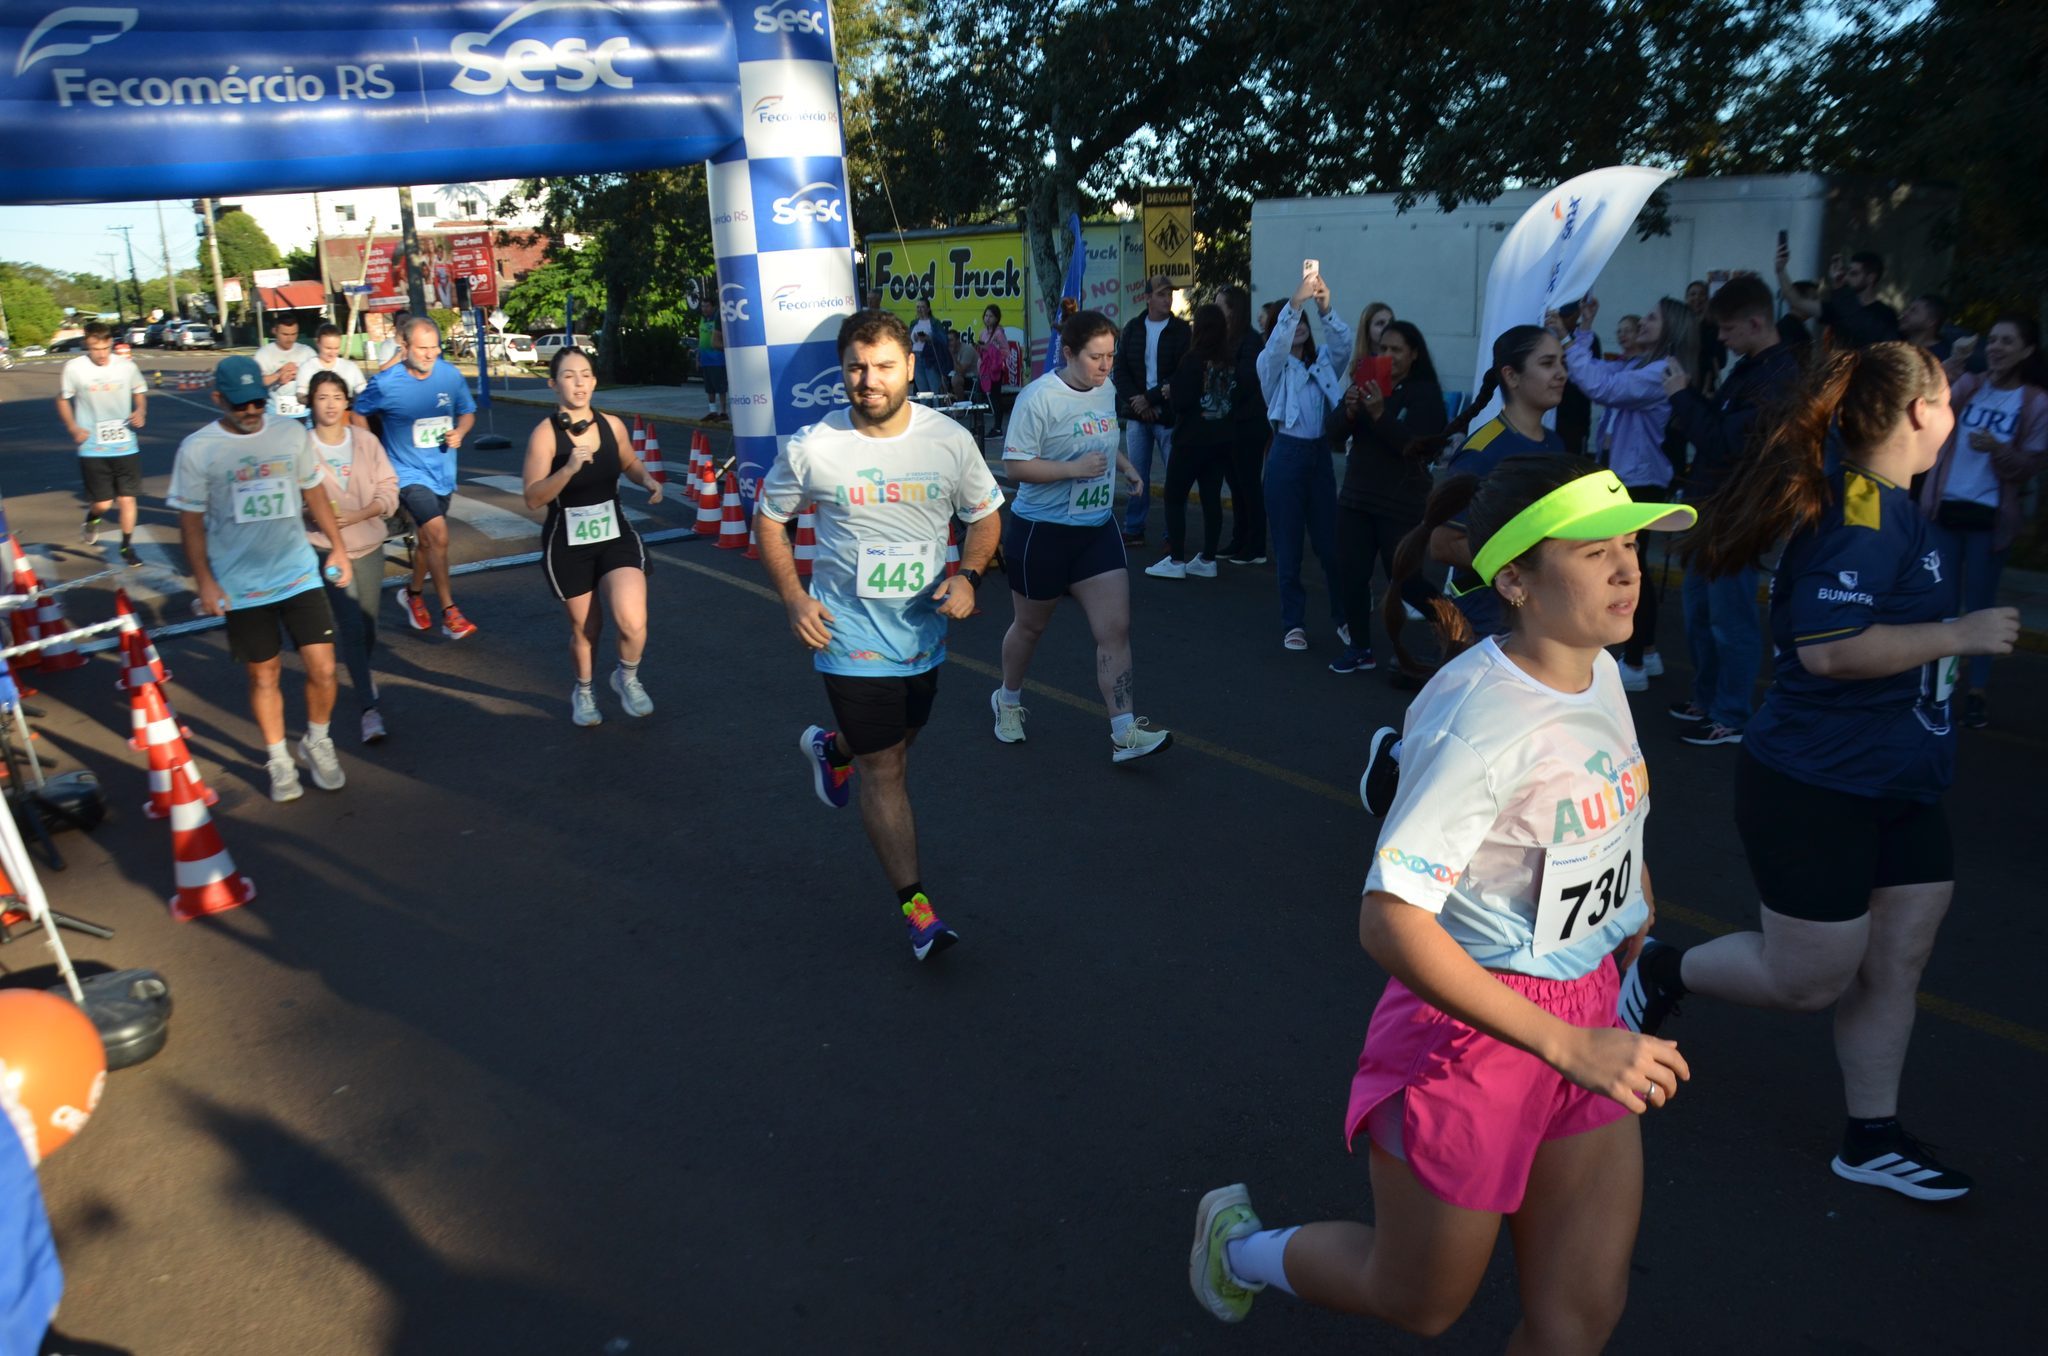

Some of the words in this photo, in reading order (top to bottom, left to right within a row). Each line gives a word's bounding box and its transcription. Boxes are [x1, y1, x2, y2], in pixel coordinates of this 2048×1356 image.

[754, 5, 824, 35] Sesc
[450, 31, 633, 95] Sesc
[53, 65, 325, 107] Fecomércio
[336, 64, 395, 100] RS
[760, 110, 826, 124] Fecoércio
[1146, 192, 1189, 204] DEVAGAR
[734, 211, 748, 222] RS
[772, 197, 842, 225] Sesc
[1082, 244, 1118, 260] ruck
[874, 250, 936, 301] Food
[949, 246, 1021, 300] Truck
[1091, 278, 1120, 298] NO
[720, 298, 750, 323] esc
[778, 298, 843, 311] Fecomércio
[845, 297, 855, 307] RS
[753, 393, 768, 405] RS
[791, 382, 850, 408] Ses
[101, 427, 126, 441] 685
[1073, 418, 1119, 438] Autism
[242, 493, 286, 518] 437
[834, 482, 940, 507] Autismo
[1076, 484, 1110, 510] 445
[575, 515, 611, 540] 467
[867, 561, 925, 593] 443
[1817, 587, 1874, 605] BUNKER
[1552, 762, 1650, 844] Autism
[1559, 849, 1631, 941] 730
